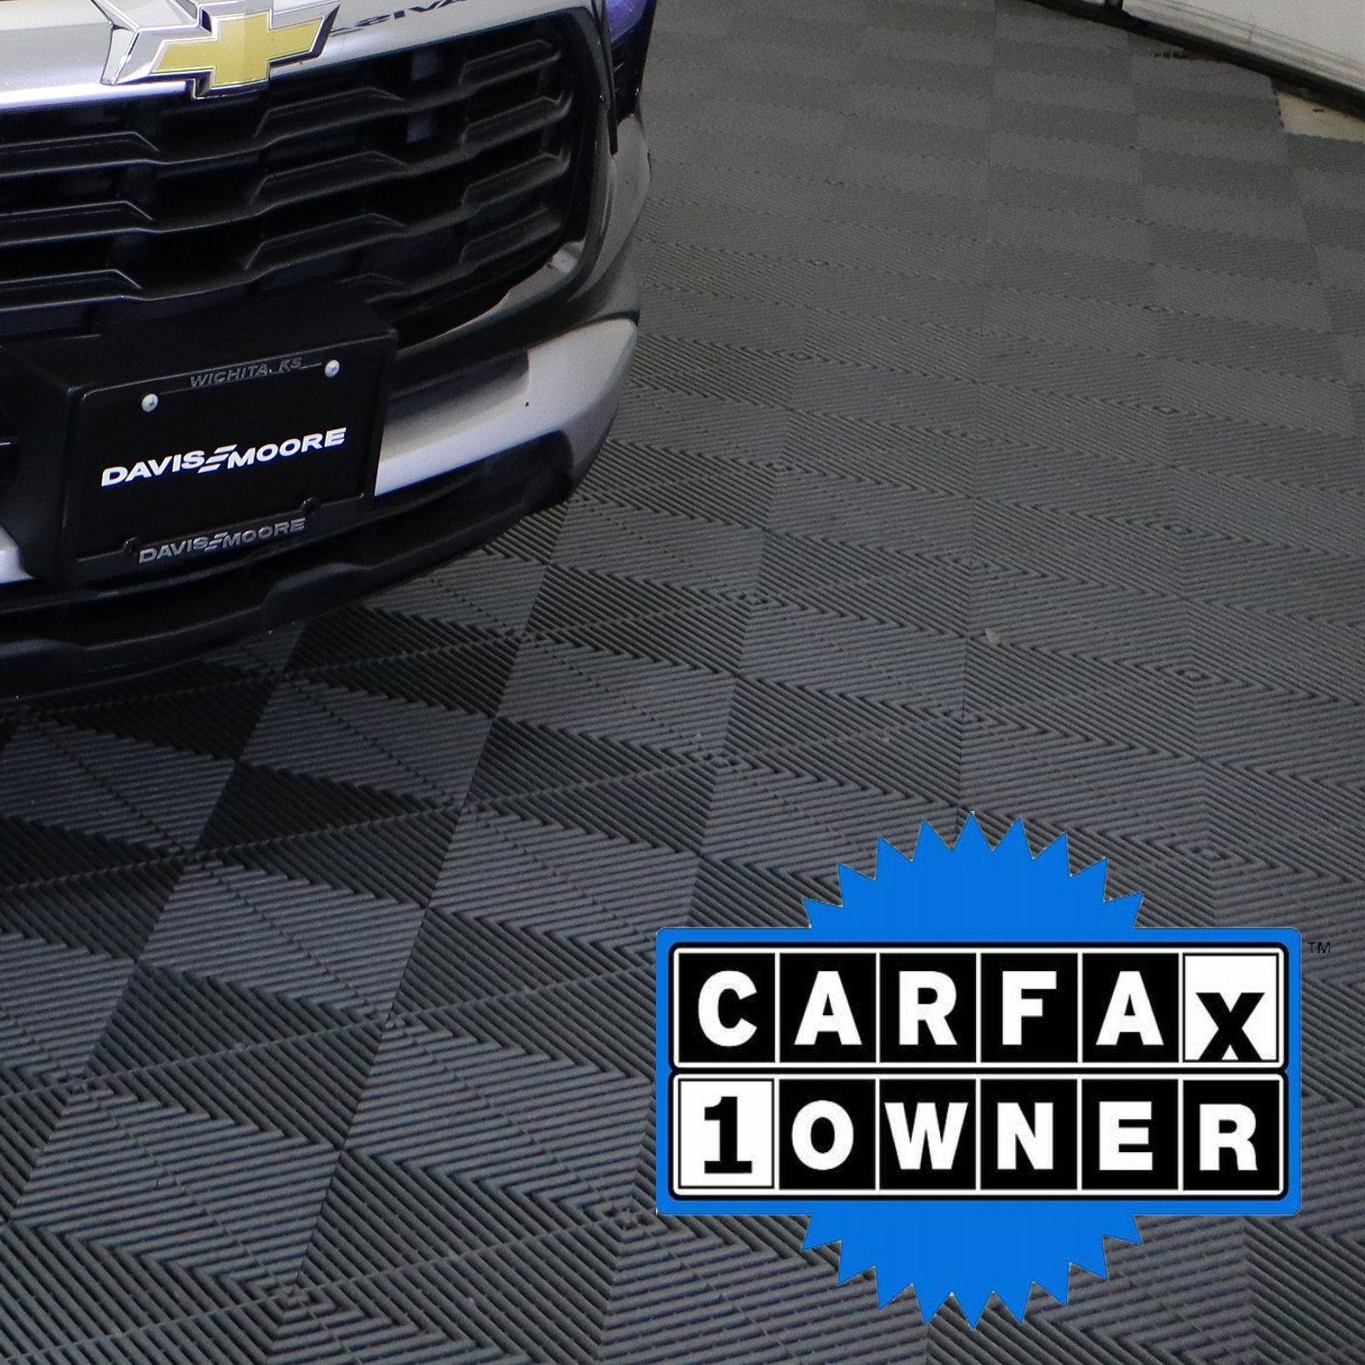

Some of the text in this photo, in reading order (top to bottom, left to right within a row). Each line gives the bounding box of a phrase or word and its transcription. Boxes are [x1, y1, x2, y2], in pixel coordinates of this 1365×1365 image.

[278, 357, 303, 374] KS
[101, 427, 347, 487] DAVIS MOORE
[138, 518, 307, 564] DAVIS MOORE
